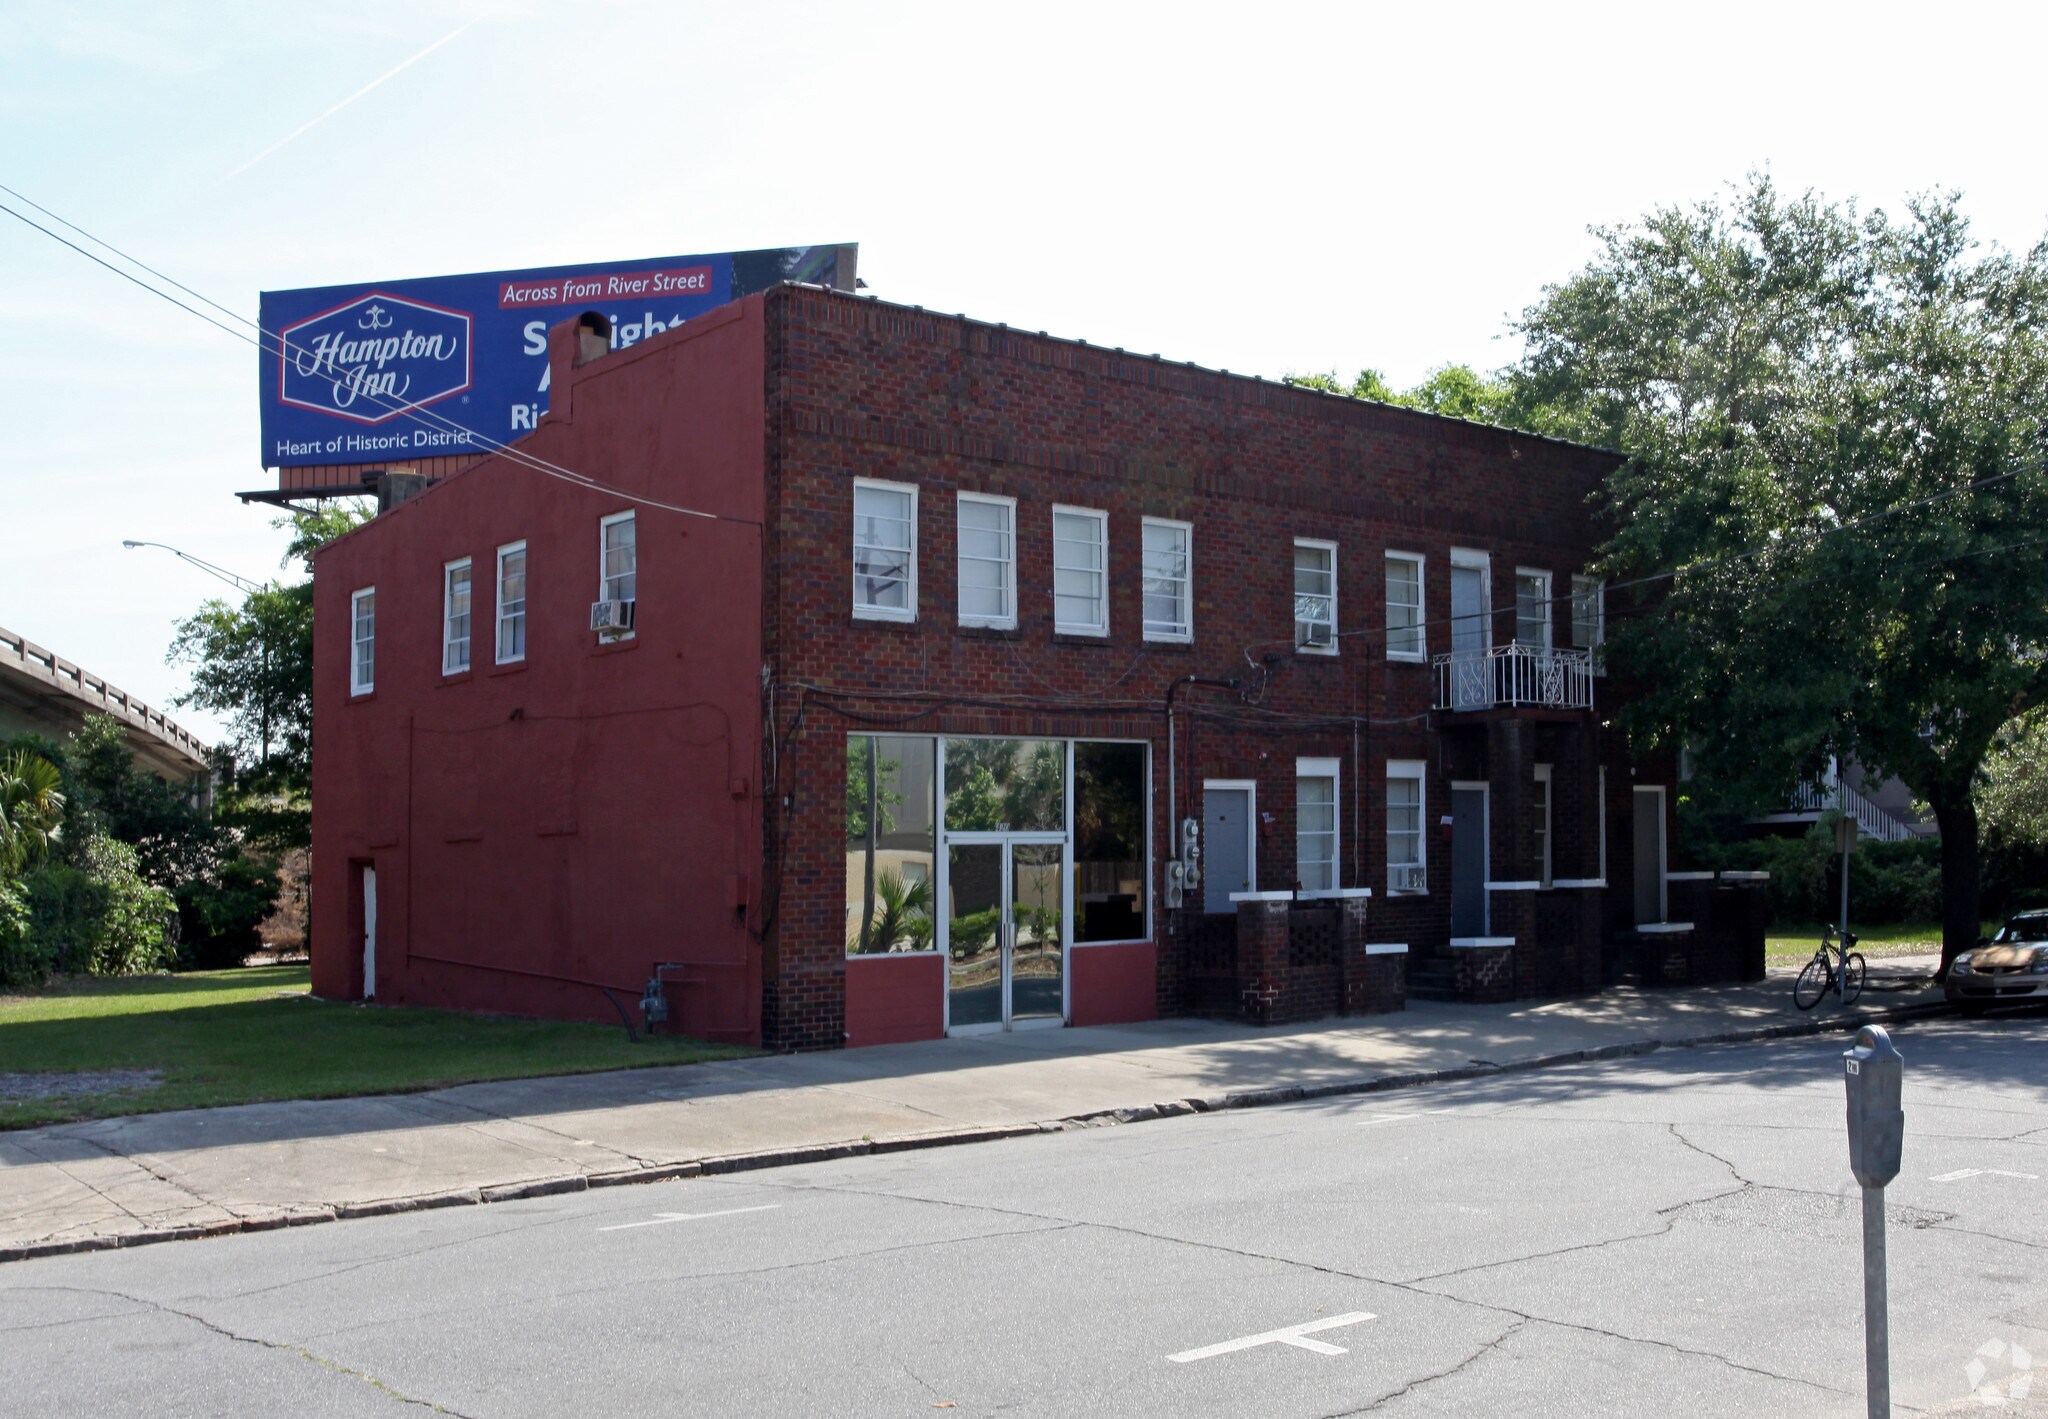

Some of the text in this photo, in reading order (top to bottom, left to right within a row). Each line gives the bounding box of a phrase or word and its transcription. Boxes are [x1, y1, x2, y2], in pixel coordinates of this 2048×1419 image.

[503, 273, 705, 303] Across from River Street
[296, 329, 457, 377] Hampton
[333, 363, 410, 408] Inn
[277, 429, 473, 457] Heart of Historic District
